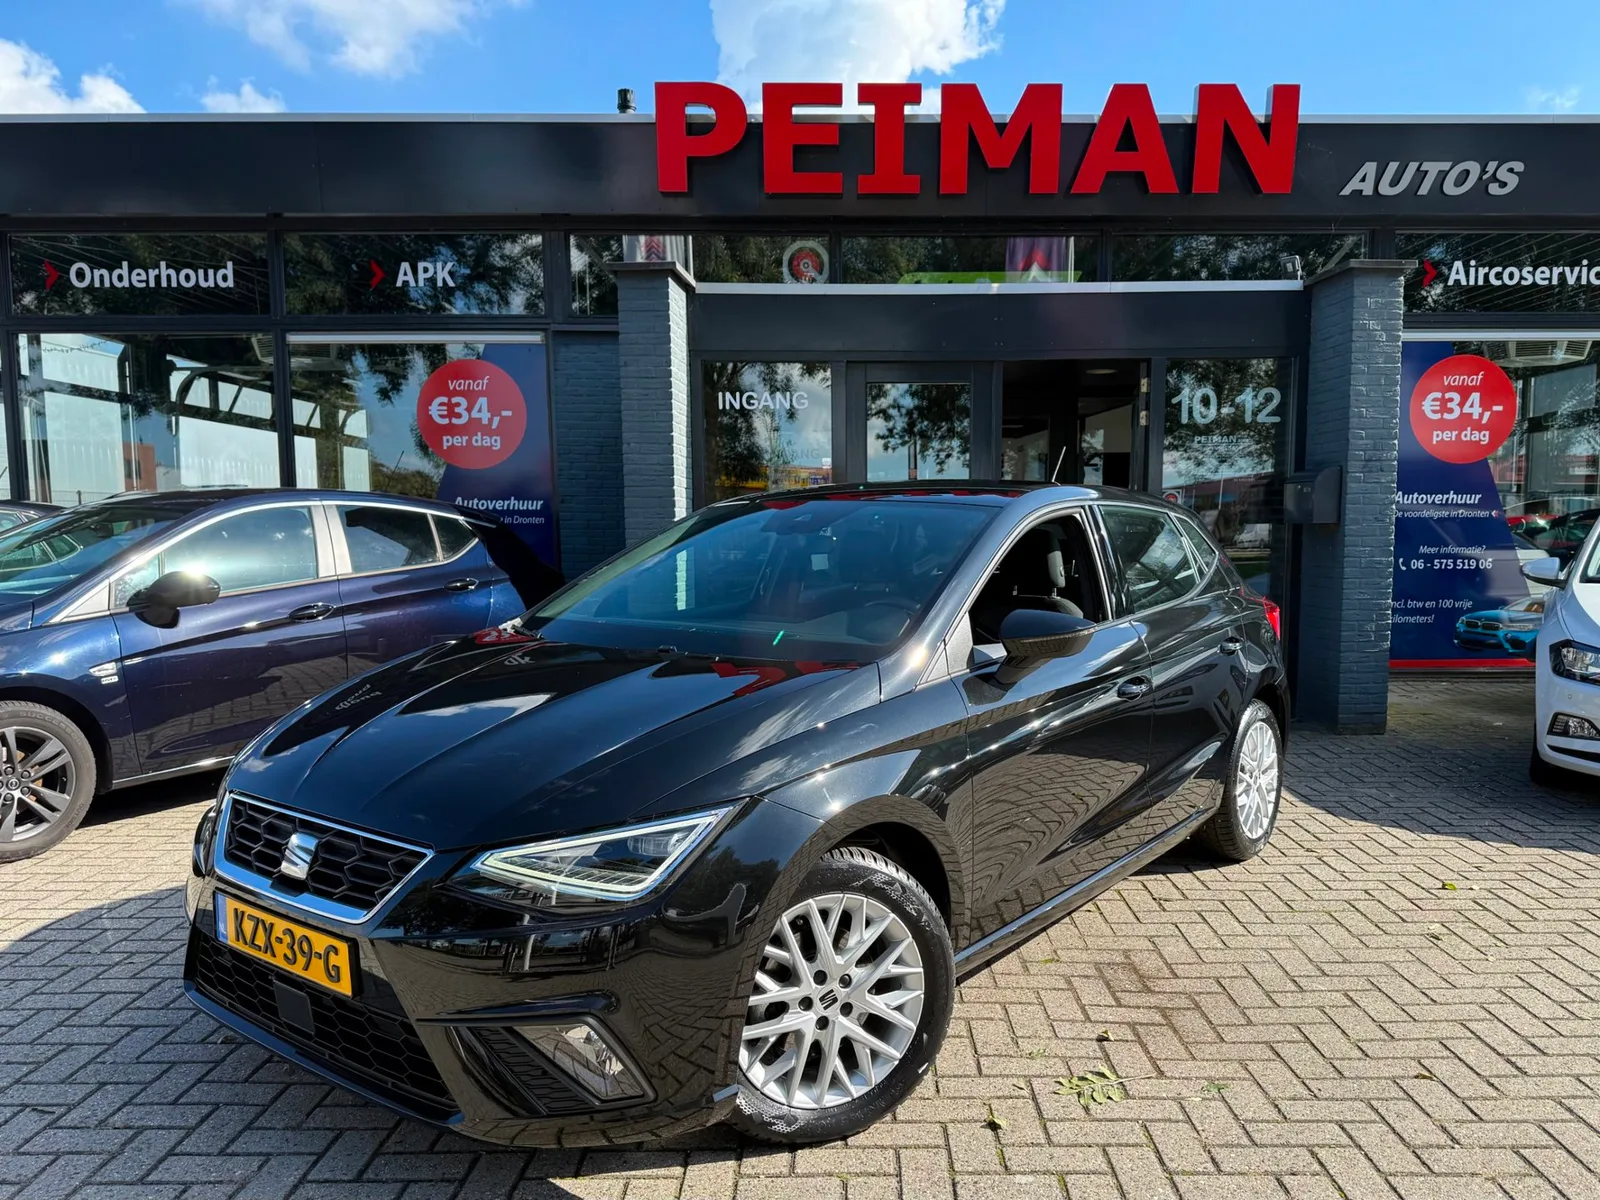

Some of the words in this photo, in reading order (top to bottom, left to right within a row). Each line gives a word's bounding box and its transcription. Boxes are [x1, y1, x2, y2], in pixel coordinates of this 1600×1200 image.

[654, 82, 1301, 195] PEIMAN
[1338, 160, 1525, 196] AUTO'S
[69, 261, 235, 289] Onderhoud
[395, 261, 456, 288] APK
[1447, 259, 1600, 286] Aircoservic
[448, 375, 490, 392] vanaf
[1443, 370, 1485, 387] vanaf
[717, 391, 809, 410] INGANG
[1170, 386, 1282, 424] 10-12
[1421, 391, 1504, 424] €34,-
[428, 396, 513, 429] €34,-
[442, 434, 469, 450] per
[471, 431, 501, 451] dag
[1432, 429, 1458, 444] per
[1461, 427, 1490, 445] dag
[455, 496, 544, 510] Autoverhuur
[1395, 490, 1482, 504] Autoverhuur
[504, 515, 512, 524] in
[513, 515, 545, 524] Dronten
[1404, 509, 1449, 520] voordeligste
[1450, 510, 1458, 518] in
[1459, 509, 1489, 518] Dronten
[1418, 545, 1439, 554] Meer
[1440, 545, 1486, 554] informatie?
[1410, 559, 1425, 570] 06
[1433, 559, 1454, 570] 575
[1456, 559, 1477, 570] 519
[1478, 558, 1493, 570] 06
[1391, 599, 1406, 609] ncl.
[1407, 599, 1425, 609] btw
[1425, 600, 1436, 609] en
[1438, 599, 1454, 609] 100
[1454, 599, 1473, 610] vrije
[1391, 614, 1435, 624] ilometers!
[233, 907, 341, 984] KZX-39-G
